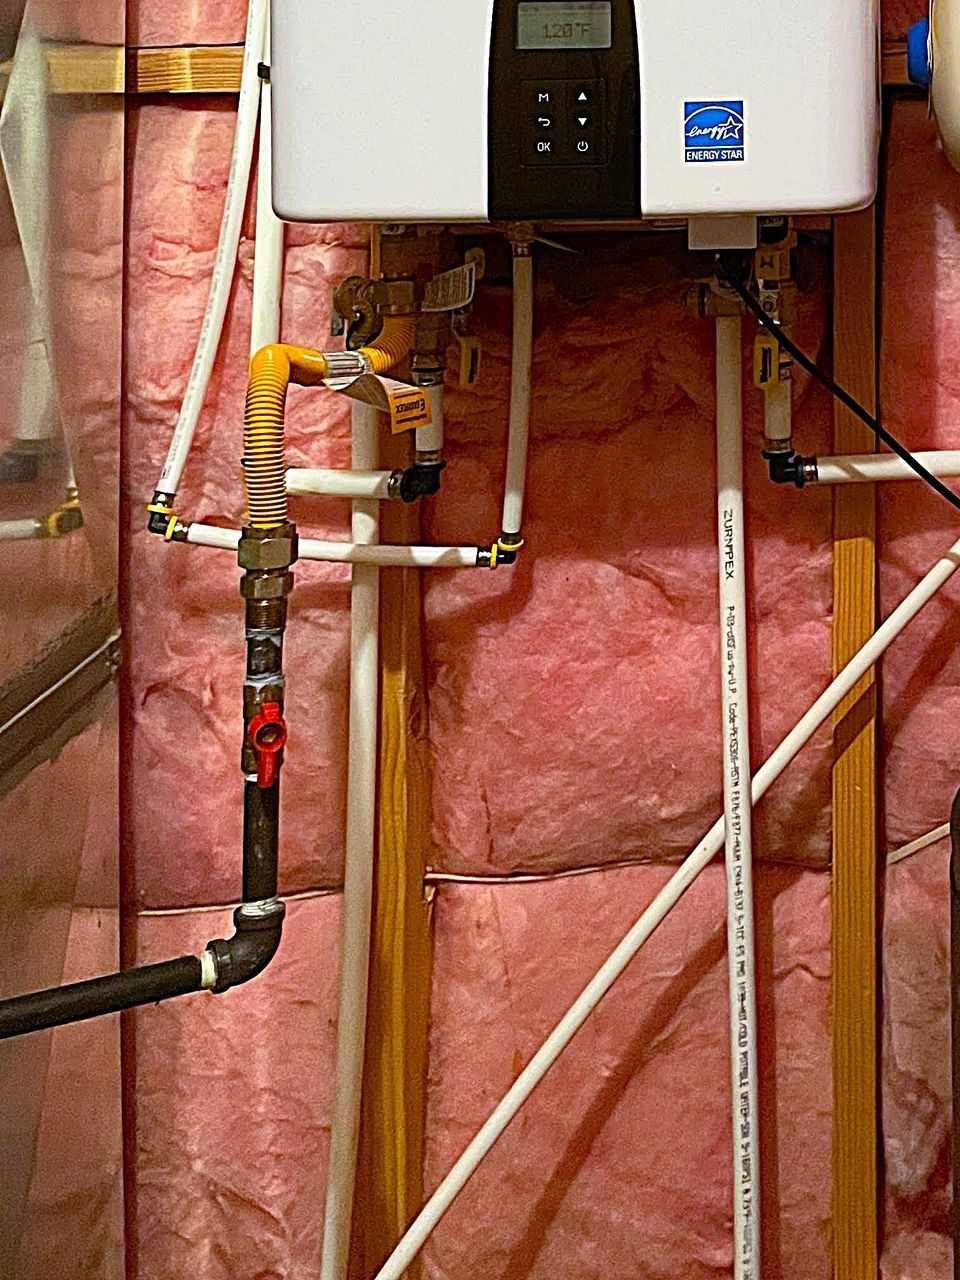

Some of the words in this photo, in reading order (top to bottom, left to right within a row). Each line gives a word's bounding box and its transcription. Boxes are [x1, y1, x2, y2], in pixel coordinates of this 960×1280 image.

[538, 93, 549, 102] M
[686, 125, 727, 140] energy
[537, 142, 551, 152] OK
[686, 149, 720, 161] ENERGY
[720, 148, 743, 159] STAR
